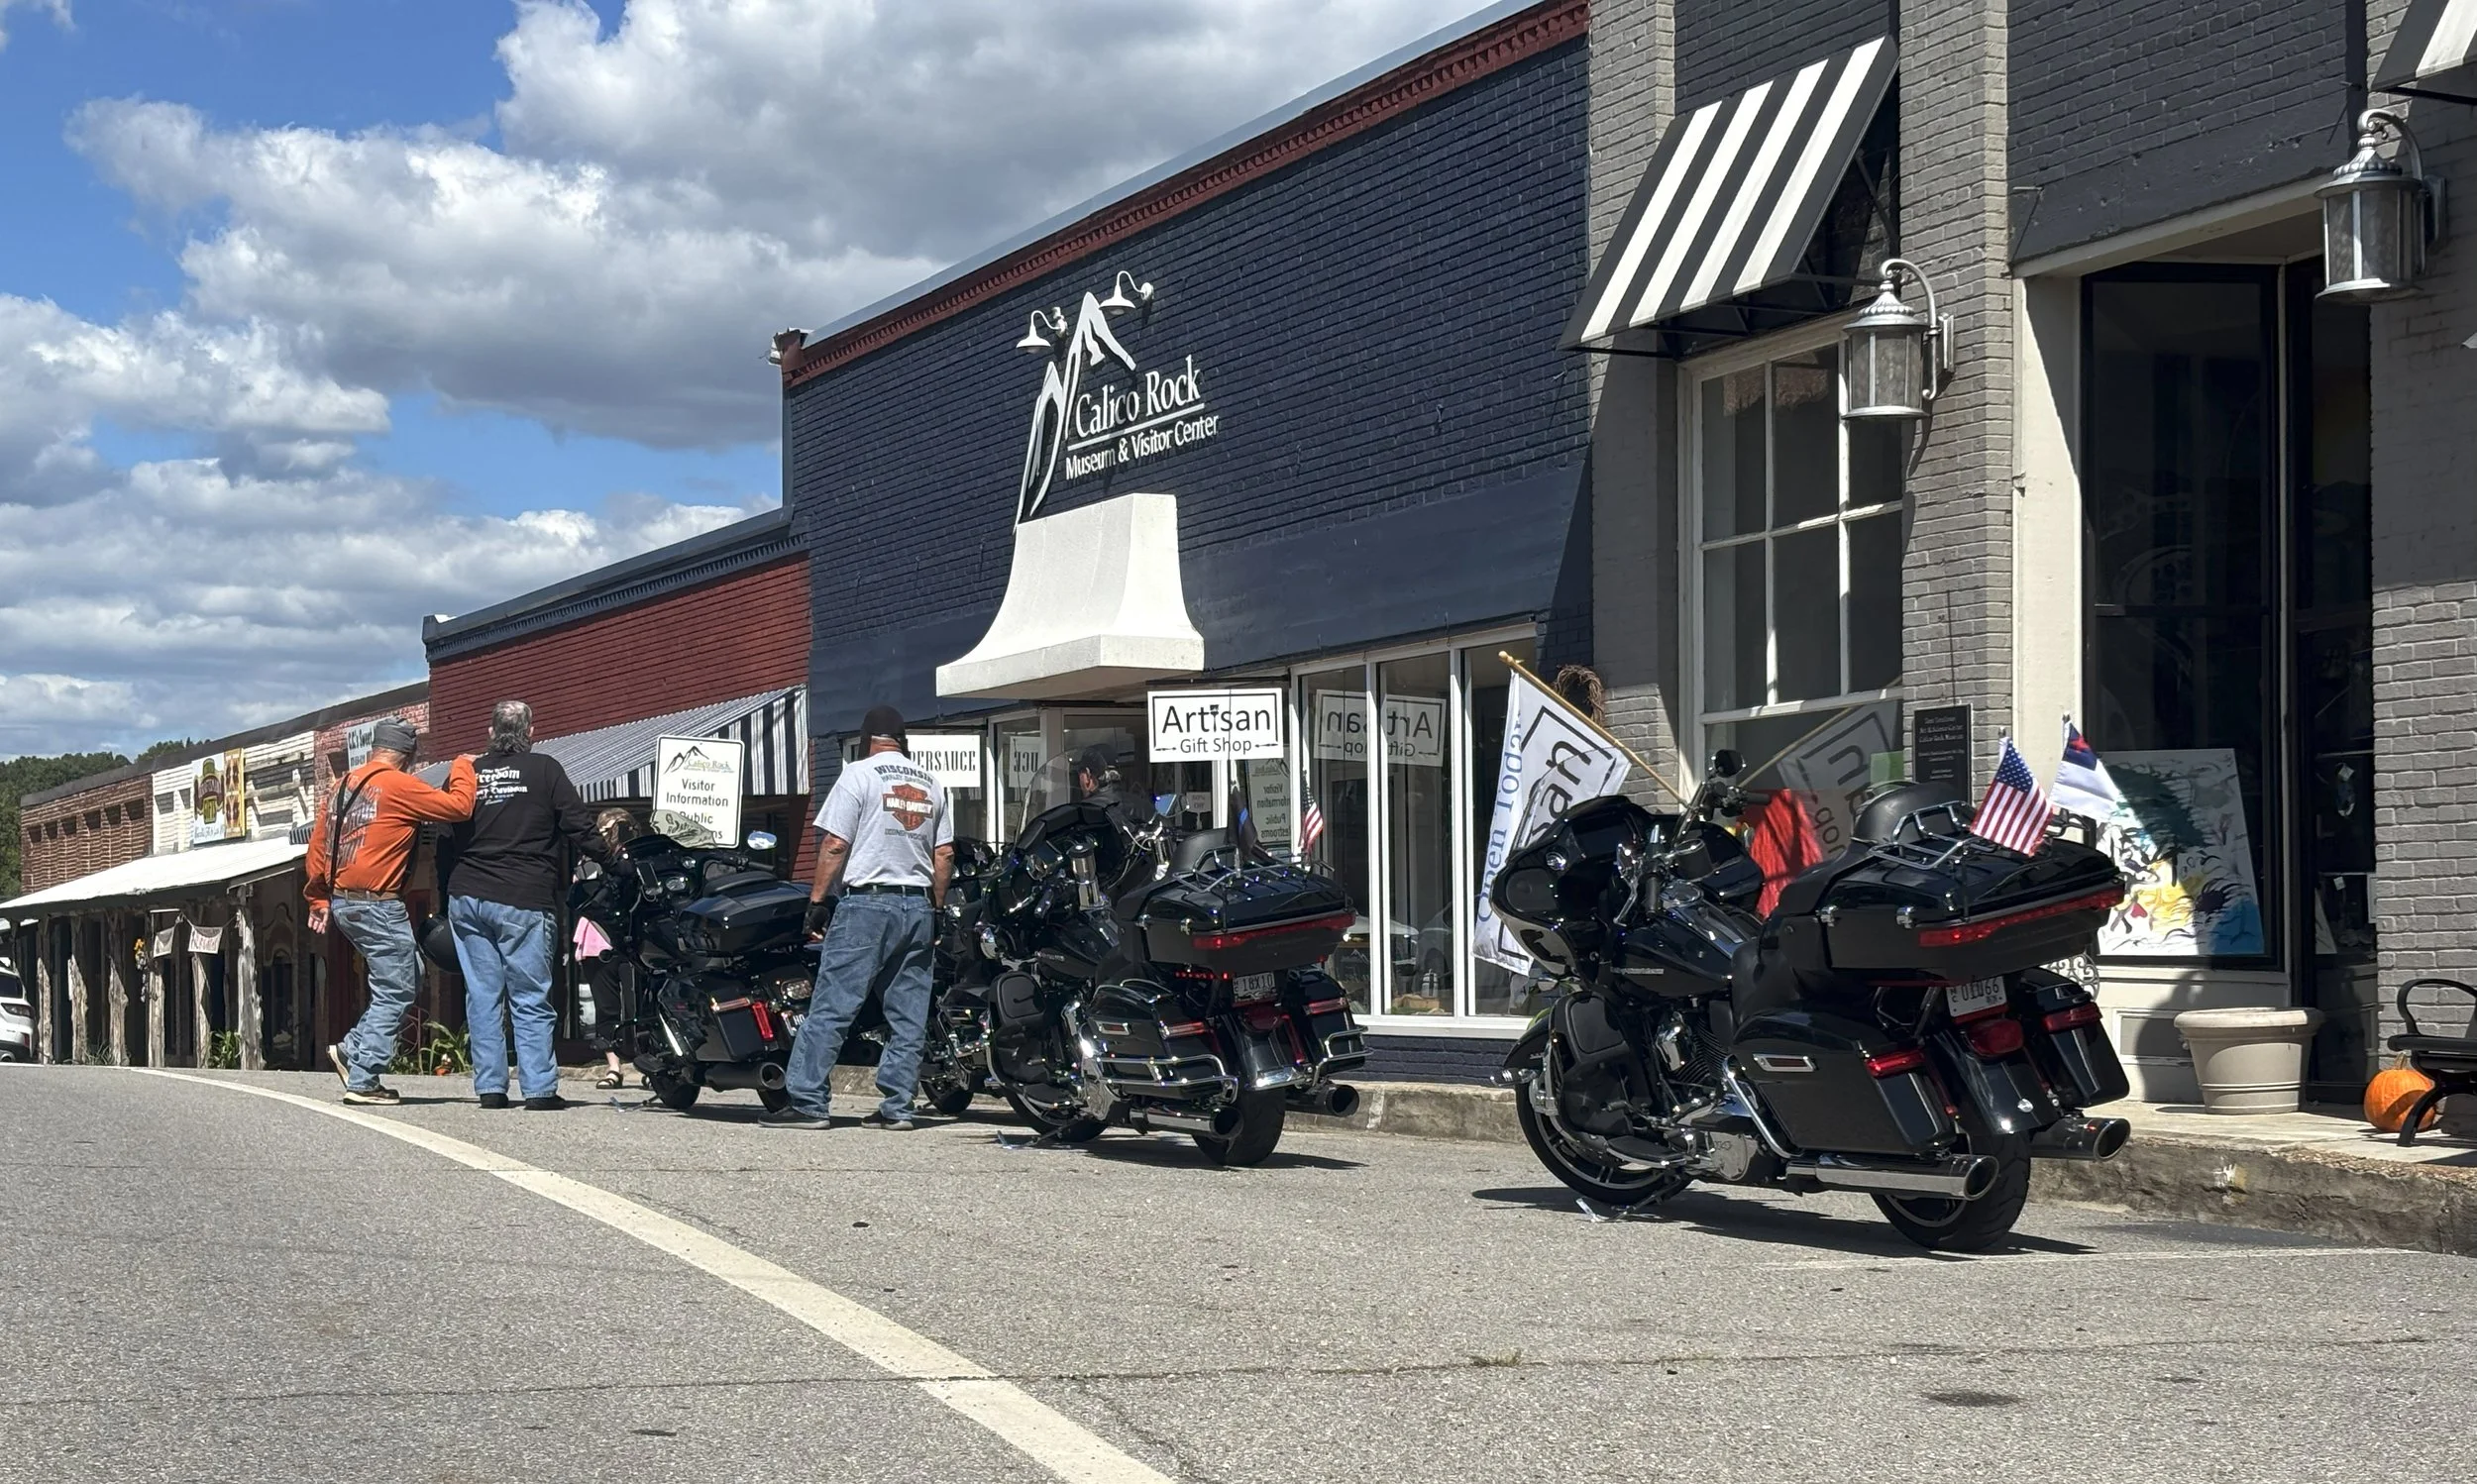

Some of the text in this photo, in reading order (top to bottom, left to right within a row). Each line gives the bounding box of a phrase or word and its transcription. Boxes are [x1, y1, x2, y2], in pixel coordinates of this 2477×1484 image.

[1076, 355, 1201, 438] Calico Rock
[1066, 415, 1220, 480] Museum & Visitor Center
[1161, 703, 1271, 734] Artisan
[1180, 736, 1252, 756] Gift Shop
[682, 778, 715, 792] Visitor
[874, 764, 933, 786] WISCONSIN
[666, 792, 729, 807] Information
